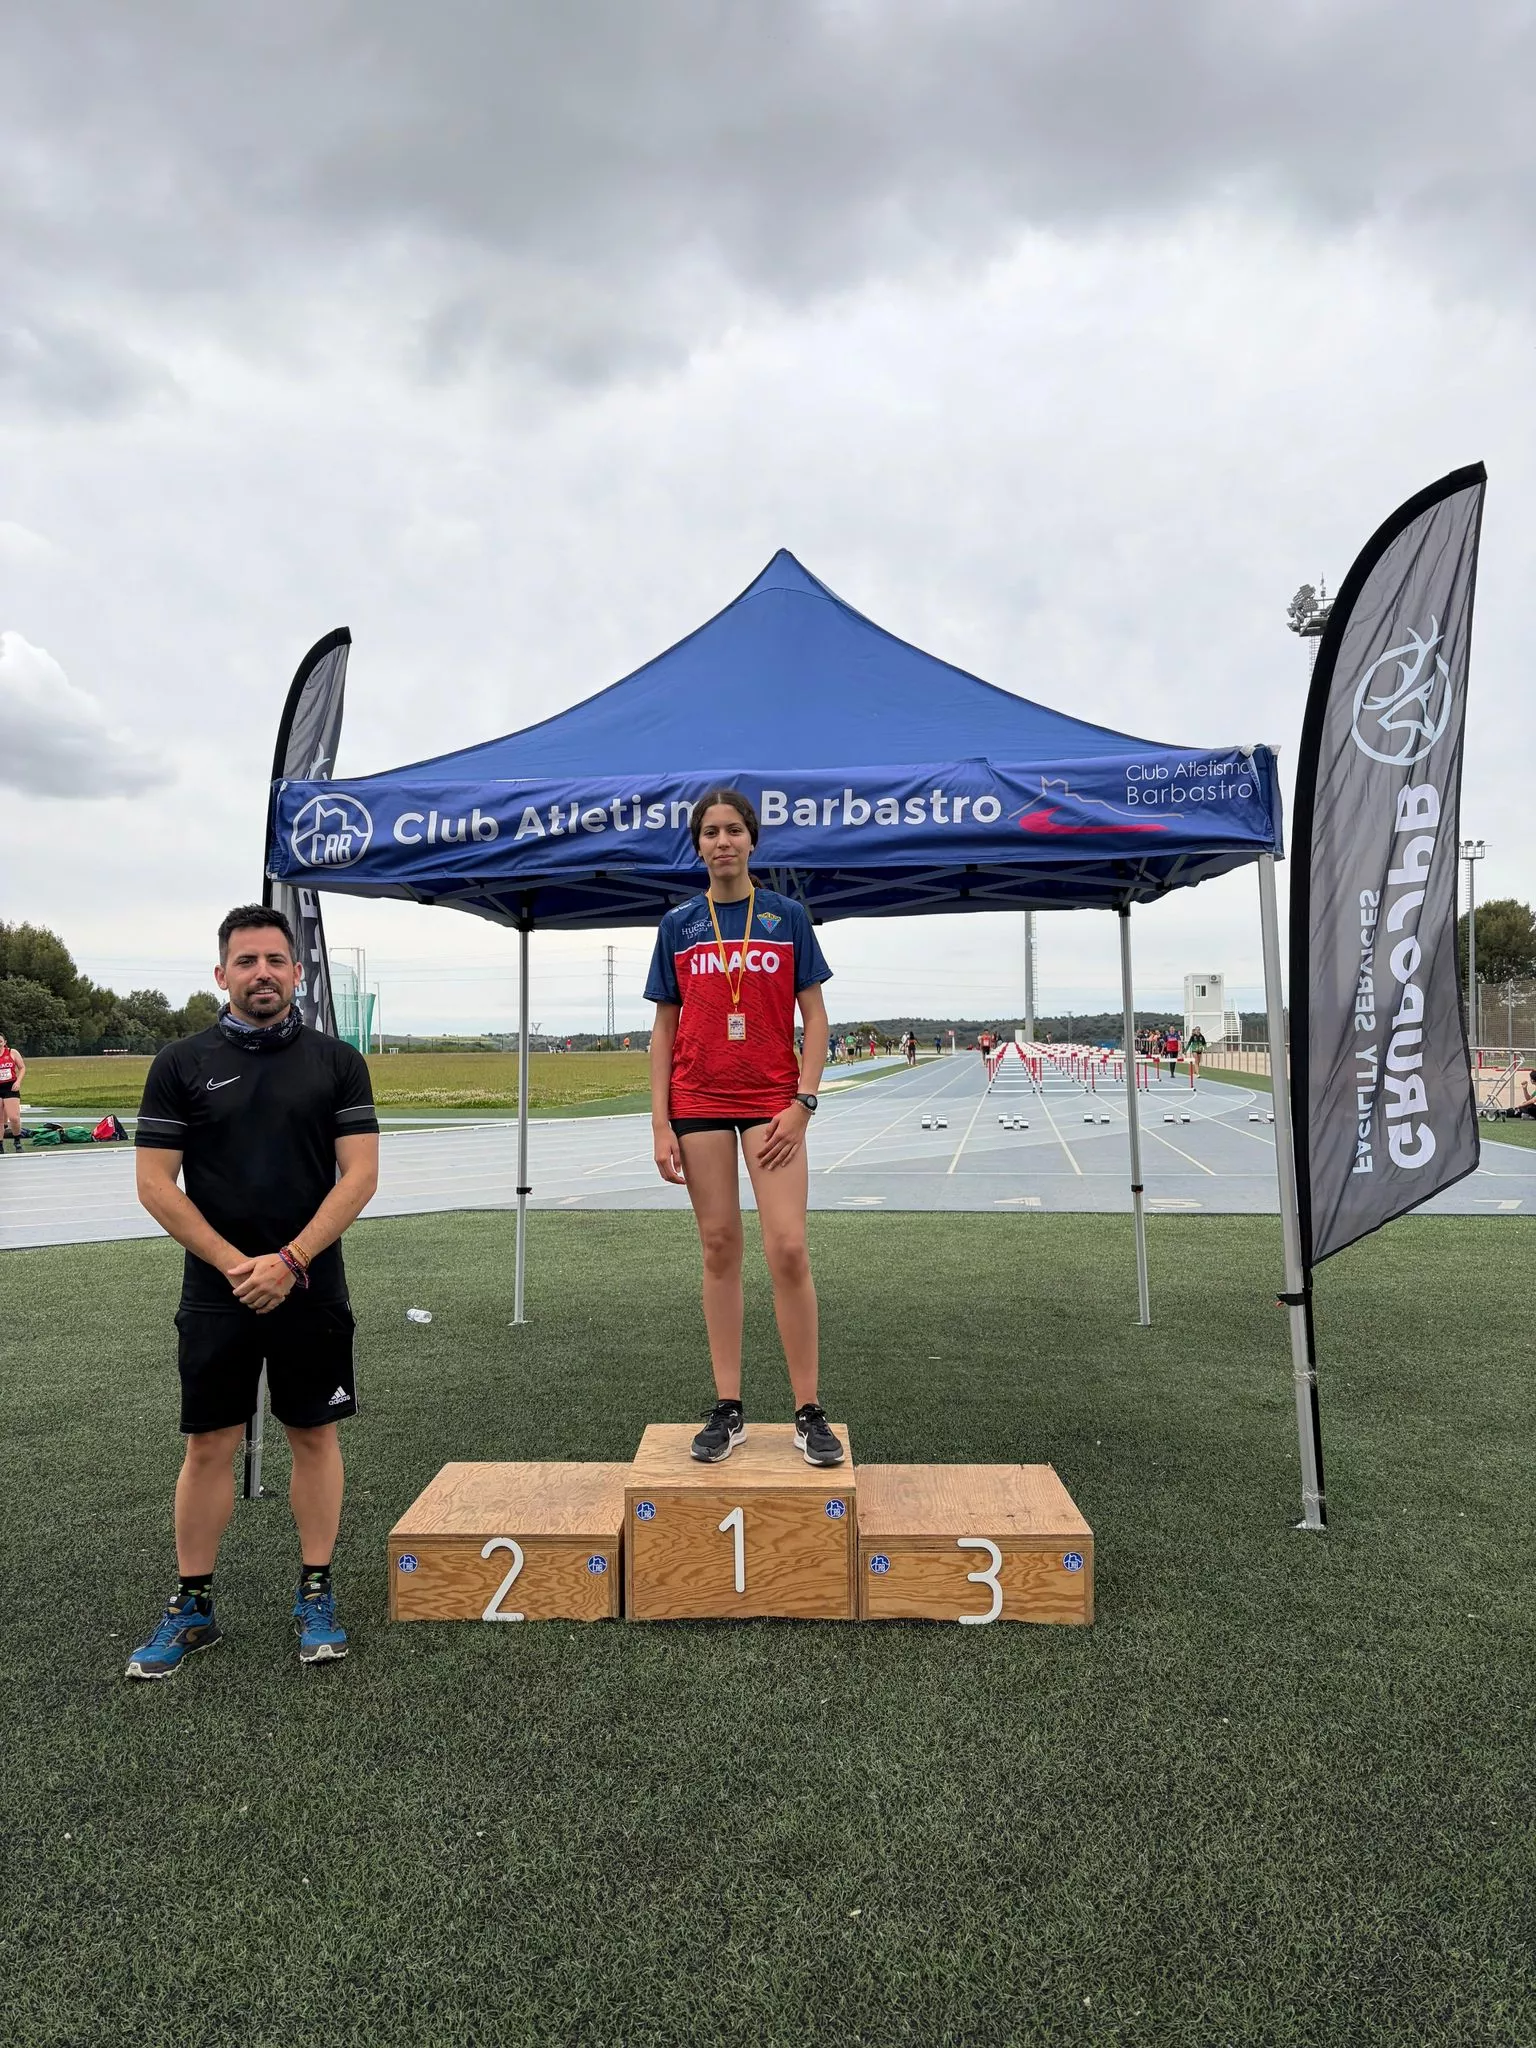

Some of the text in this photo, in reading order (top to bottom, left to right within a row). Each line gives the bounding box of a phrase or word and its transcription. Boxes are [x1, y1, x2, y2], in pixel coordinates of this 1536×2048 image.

[1126, 760, 1251, 781] Club Atletismo
[1127, 780, 1253, 805] Barbastro
[393, 789, 1001, 845] Club Atletism Barbastro
[311, 834, 352, 865] CAB
[718, 1507, 745, 1593] 1
[480, 1537, 525, 1621] 2
[957, 1538, 1003, 1624] 3
